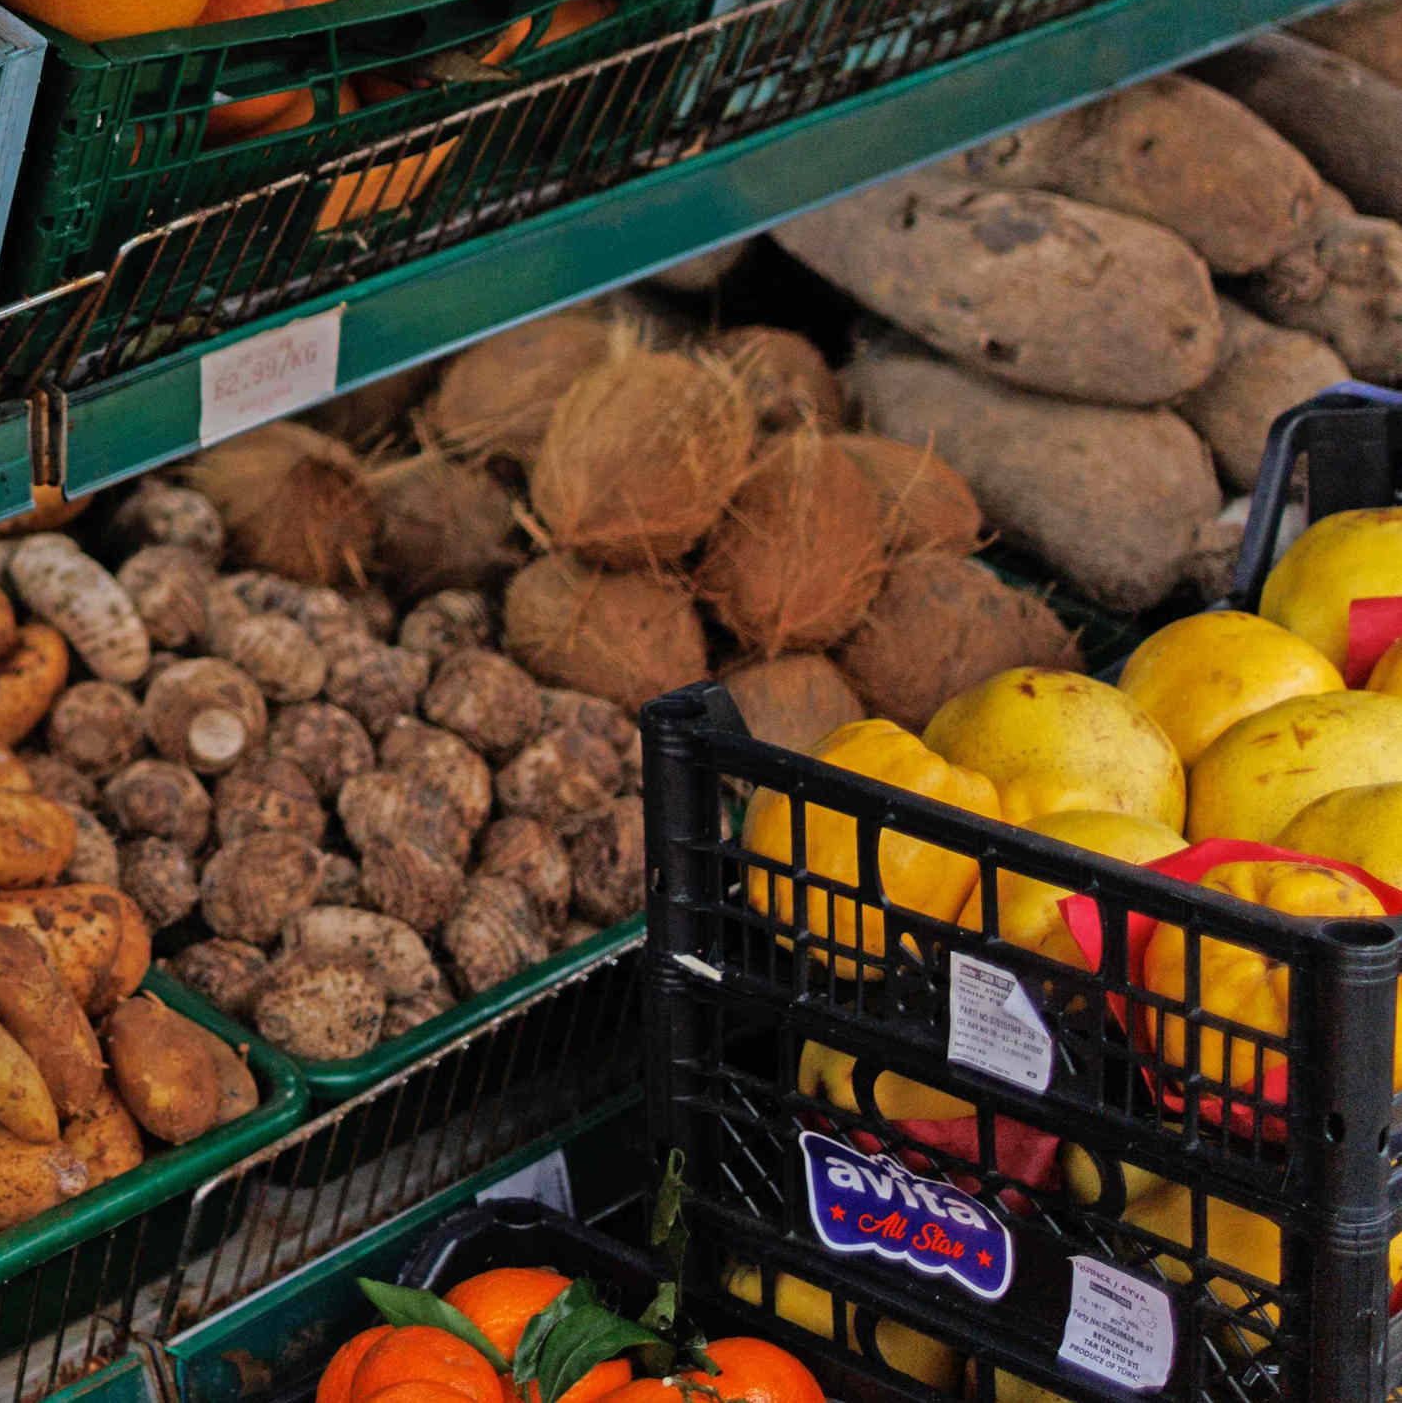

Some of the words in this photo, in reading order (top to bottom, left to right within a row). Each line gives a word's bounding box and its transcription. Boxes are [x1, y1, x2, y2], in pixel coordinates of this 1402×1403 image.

[825, 1155, 988, 1232] avita
[857, 1210, 909, 1241] All
[911, 1222, 966, 1260] Star
